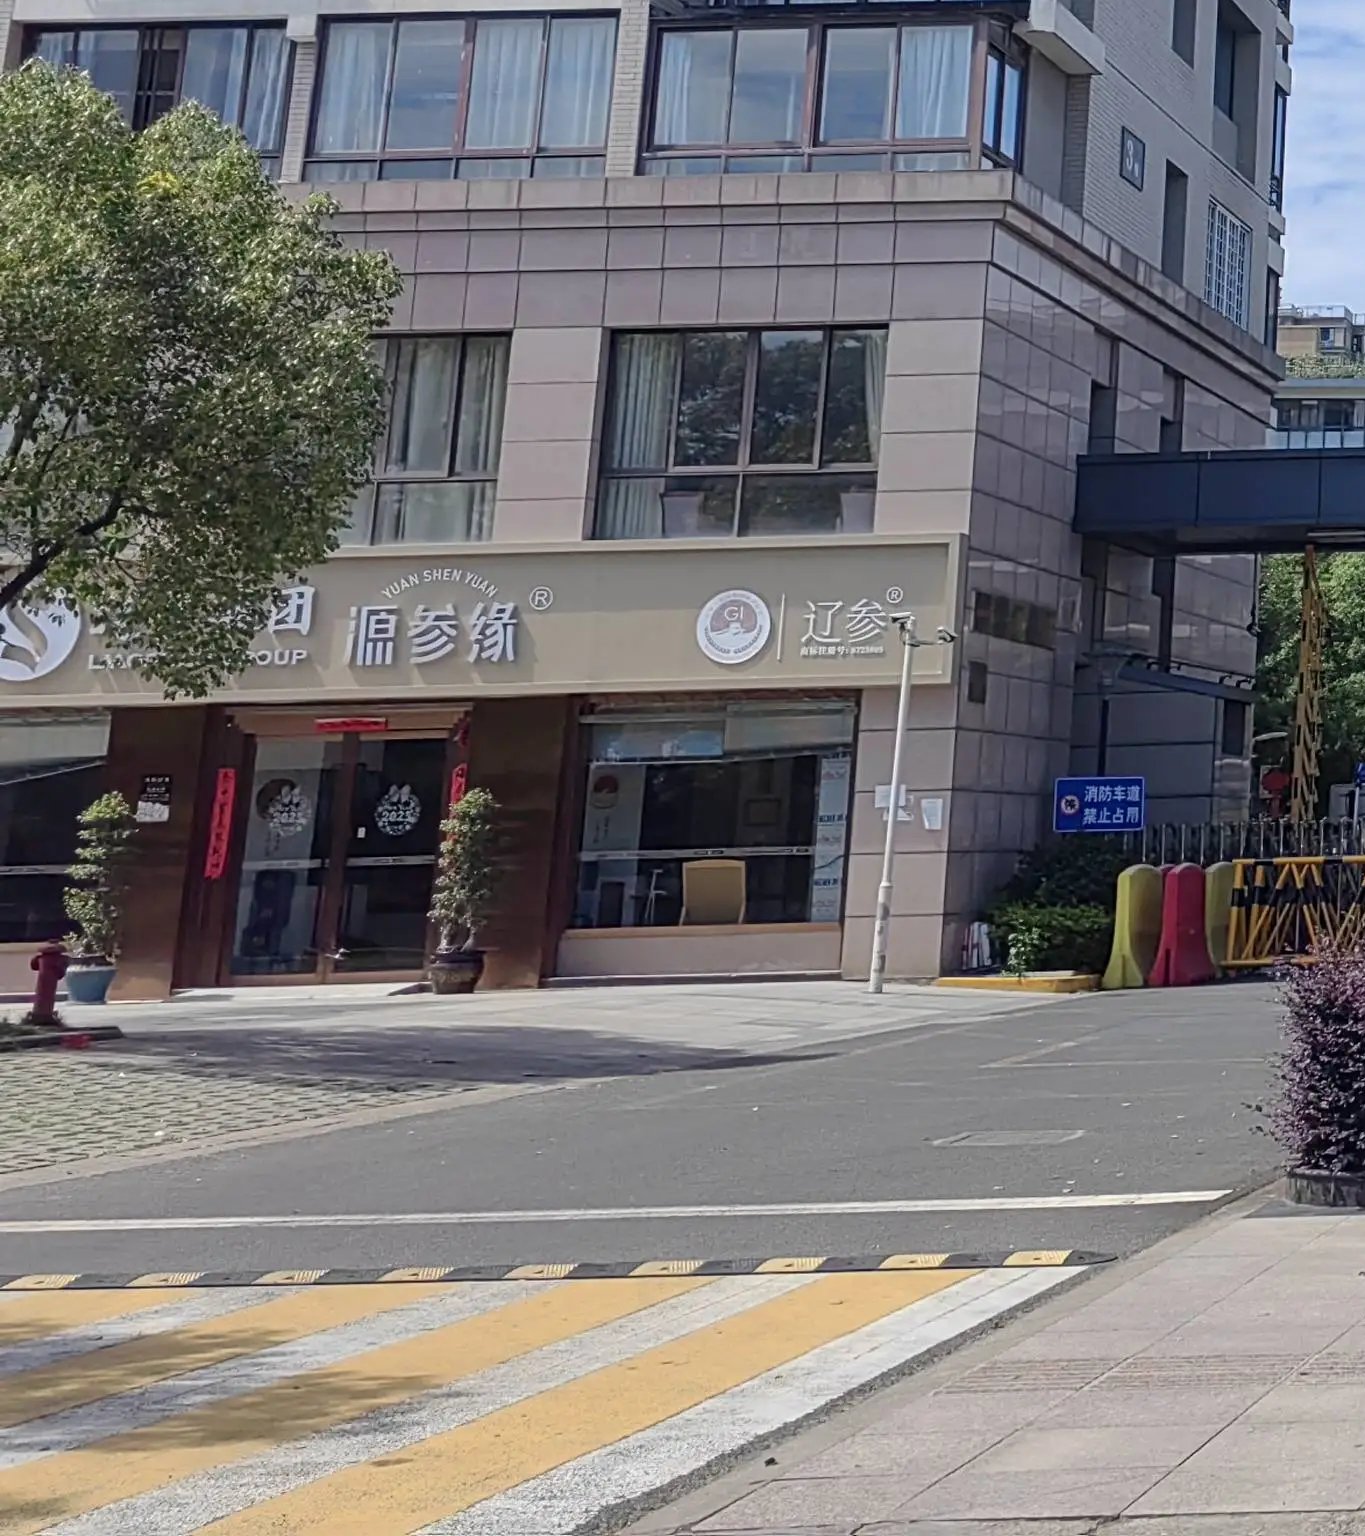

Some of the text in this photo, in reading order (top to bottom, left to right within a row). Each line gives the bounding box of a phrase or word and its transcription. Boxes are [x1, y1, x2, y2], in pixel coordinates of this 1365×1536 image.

[381, 568, 498, 599] YUAN SHEN YUAN
[724, 605, 744, 621] GI
[800, 598, 887, 643] 辽参
[343, 602, 518, 666] 源参缘
[245, 650, 308, 666] OUP
[1084, 785, 1140, 802] 消防车道
[1082, 807, 1139, 824] 禁止占用
